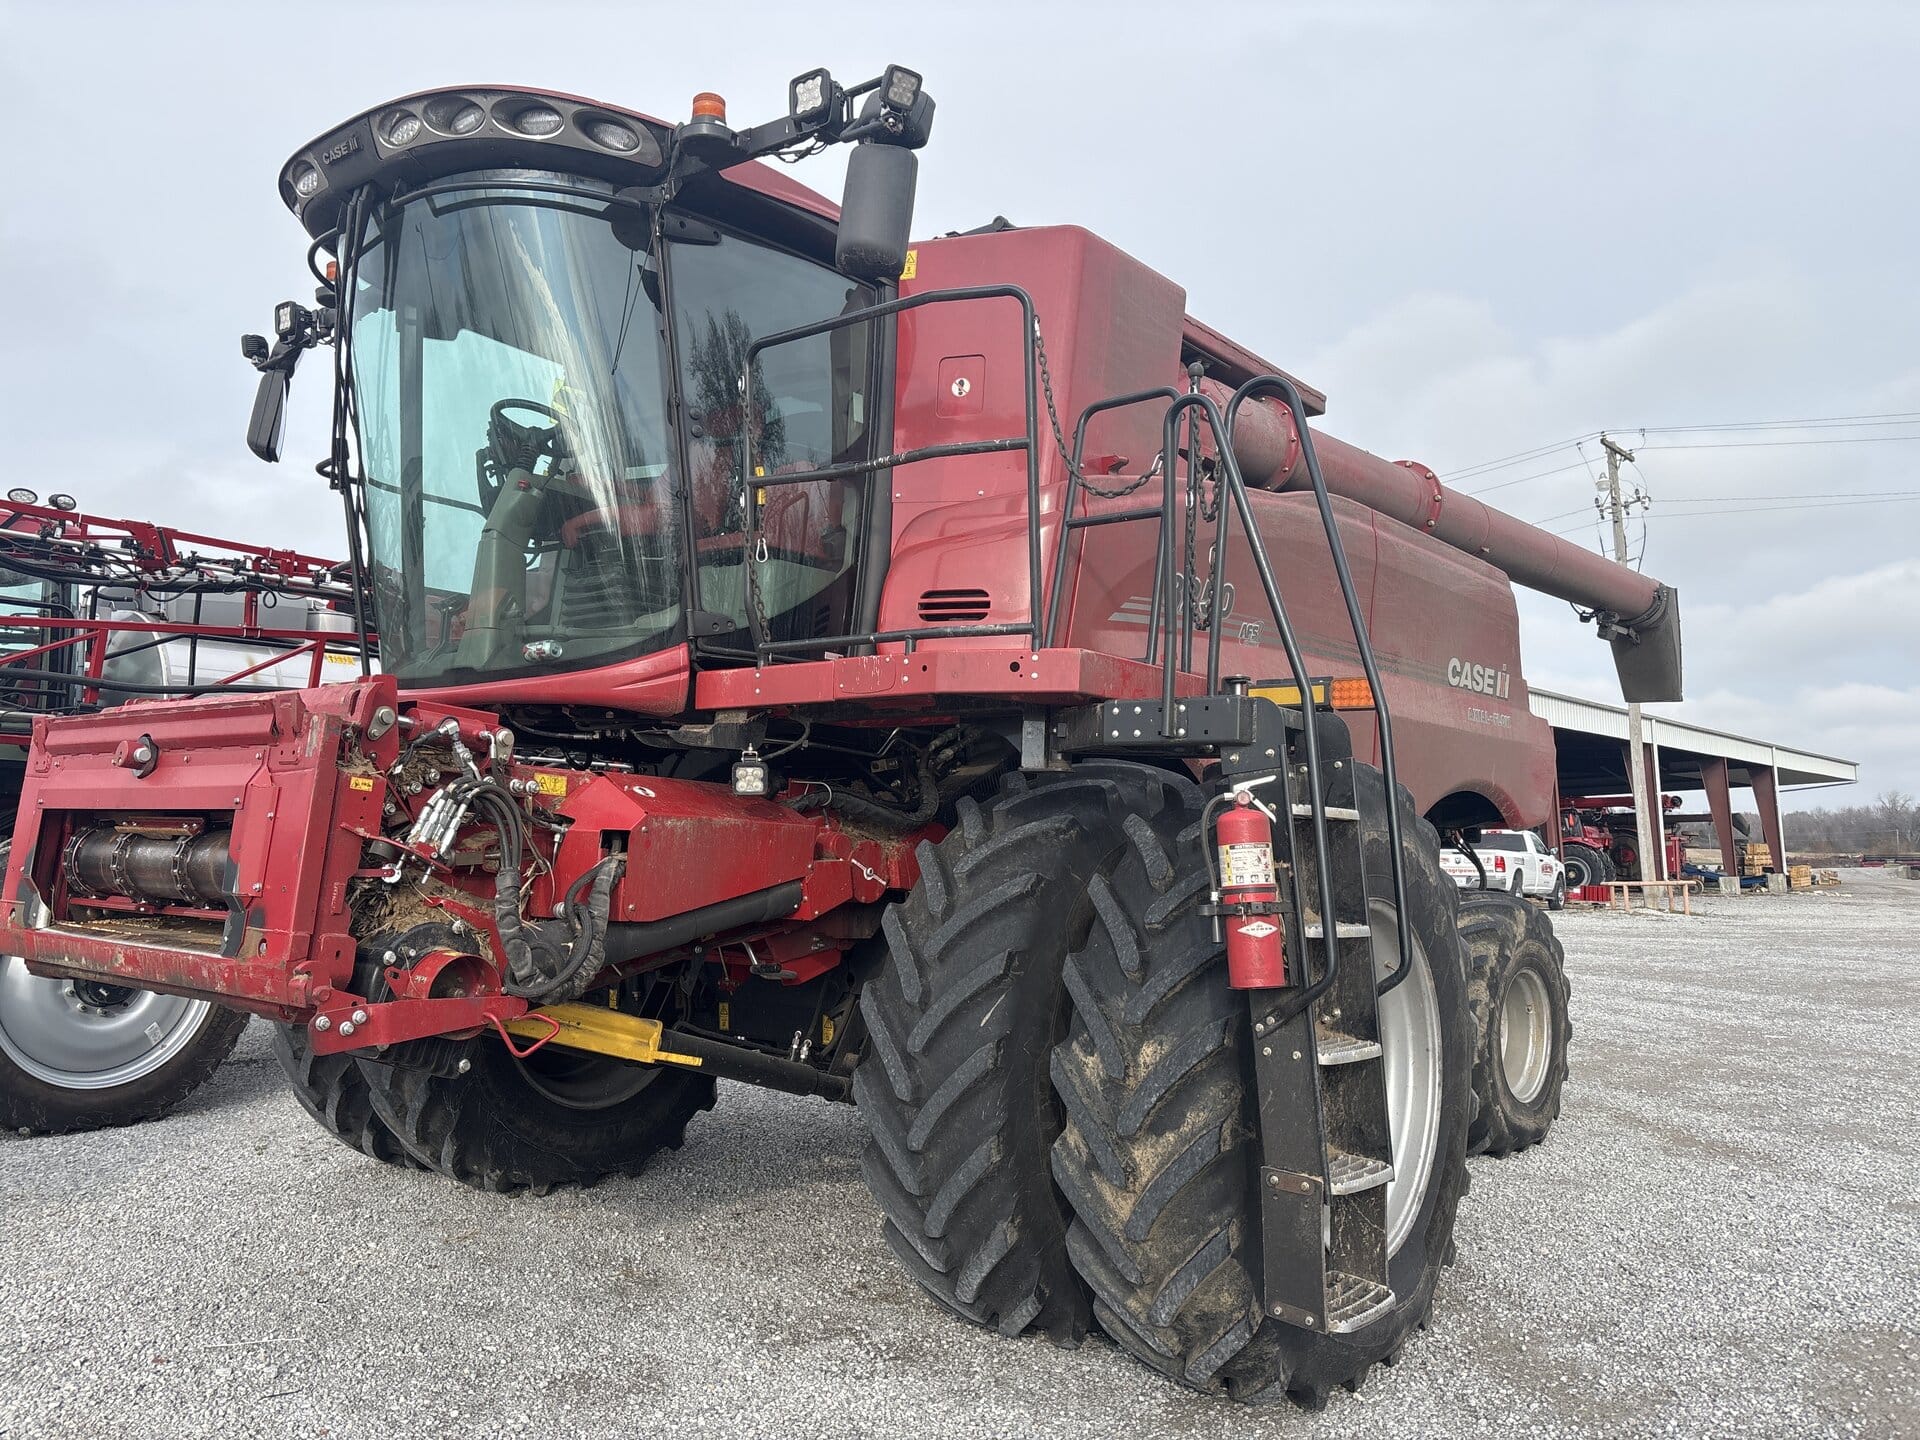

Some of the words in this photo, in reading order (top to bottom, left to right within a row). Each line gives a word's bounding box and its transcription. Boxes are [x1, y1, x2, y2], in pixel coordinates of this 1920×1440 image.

[322, 139, 348, 165] CASE
[1239, 622, 1260, 641] AFS
[1447, 657, 1495, 695] CASE
